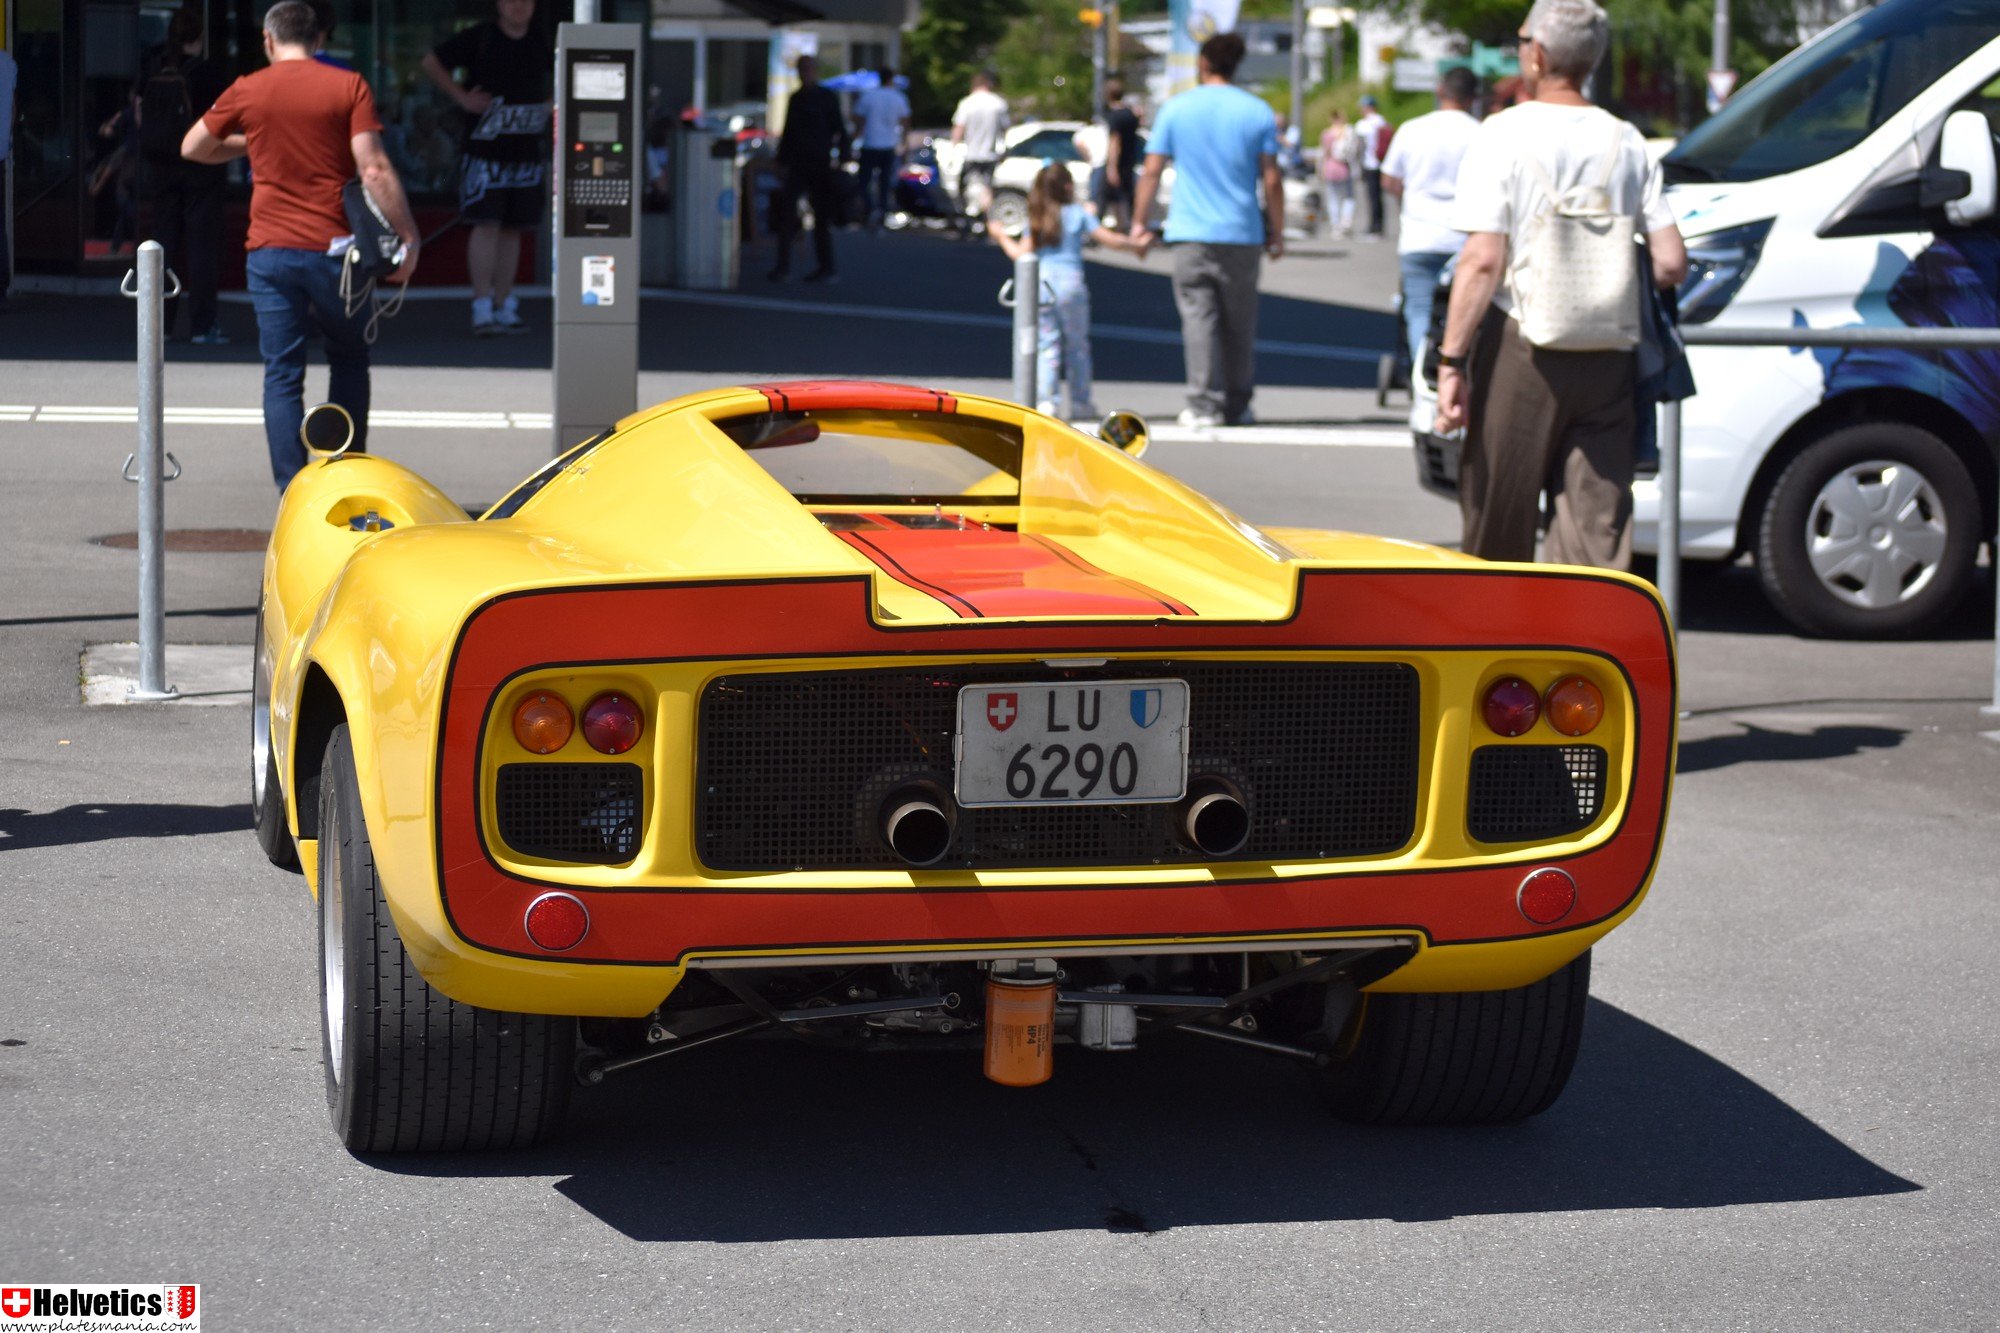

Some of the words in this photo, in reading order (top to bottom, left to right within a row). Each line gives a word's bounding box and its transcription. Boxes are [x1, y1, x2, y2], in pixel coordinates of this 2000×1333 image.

[1047, 689, 1101, 732] LU
[1006, 742, 1138, 798] 6290
[1027, 1025, 1037, 1045] HP4
